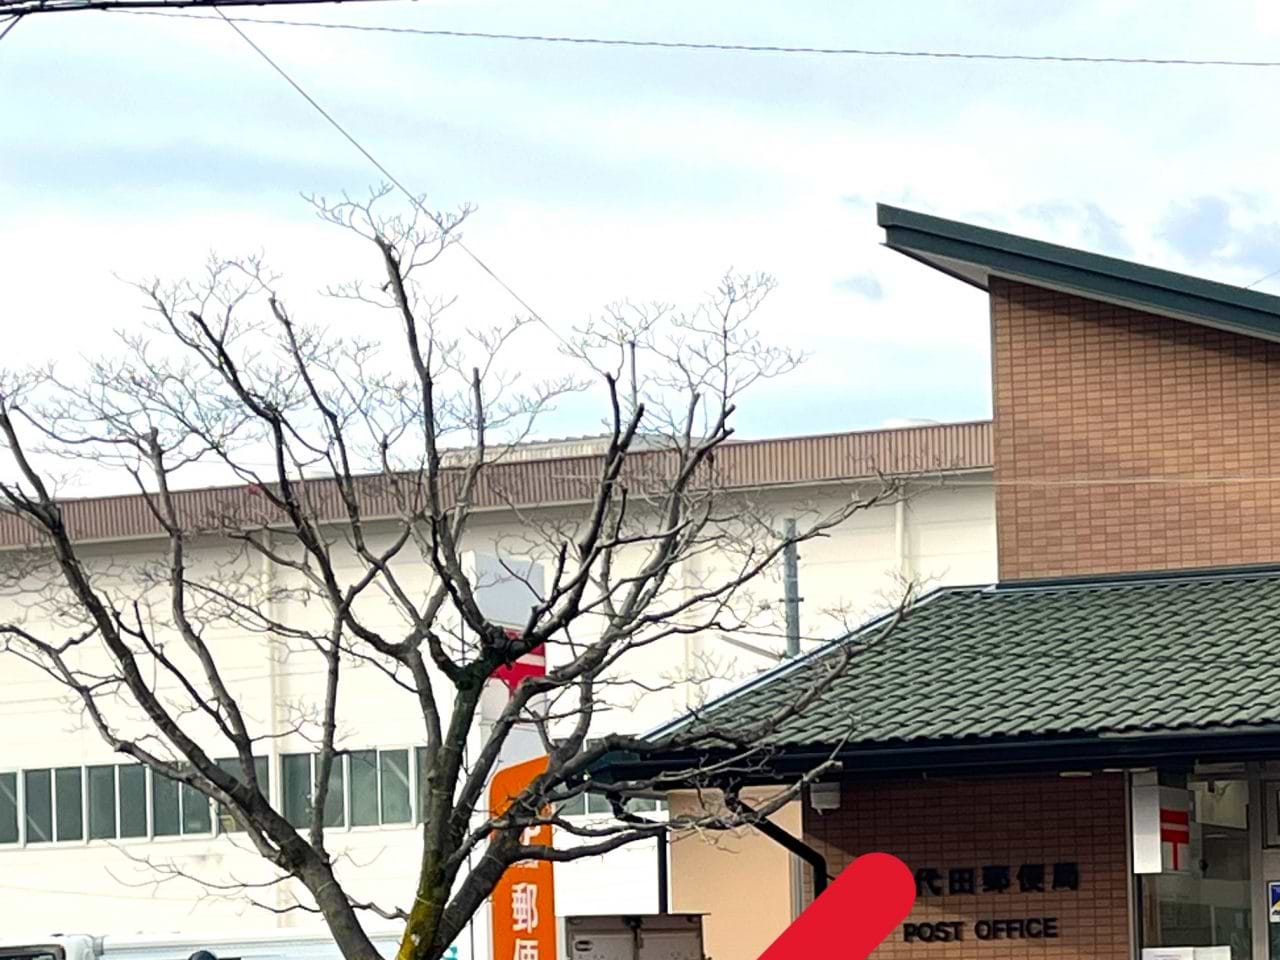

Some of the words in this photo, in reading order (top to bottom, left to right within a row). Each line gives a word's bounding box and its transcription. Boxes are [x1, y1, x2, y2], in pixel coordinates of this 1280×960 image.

[914, 863, 1078, 896] 代田郵便局
[903, 921, 964, 942] POST
[975, 918, 1058, 940] OFFICE
